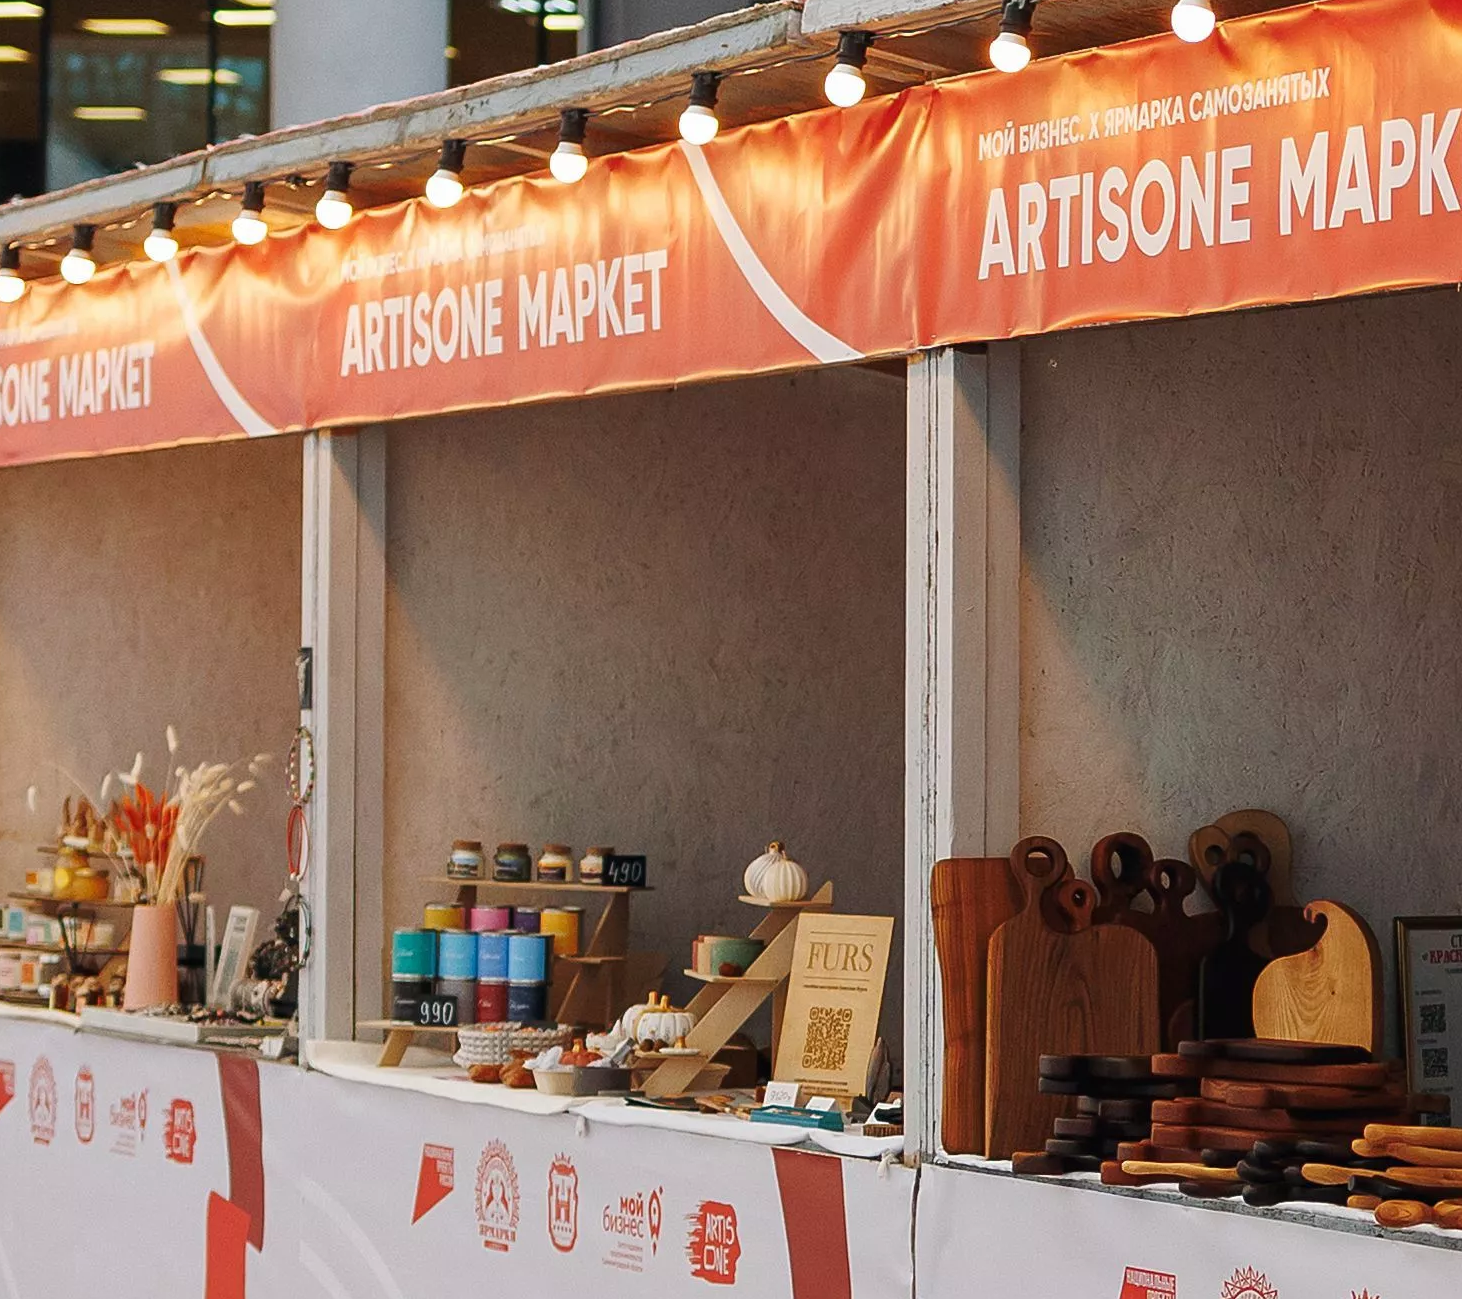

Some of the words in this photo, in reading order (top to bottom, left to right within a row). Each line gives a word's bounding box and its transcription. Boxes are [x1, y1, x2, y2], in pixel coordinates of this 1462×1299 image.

[978, 119, 1015, 161] МОЙ
[1019, 112, 1085, 156] БИЗНЕС.
[1103, 95, 1185, 138] ЯРМАРКА
[1189, 67, 1331, 123] САМОЗАНЯТЫХ
[978, 145, 1252, 280] ARTISONE
[340, 279, 504, 377] ARTISONE
[518, 249, 667, 350] МАРКЕТ
[58, 341, 155, 419] МАРКЕТ
[609, 864, 642, 883] 490
[806, 942, 874, 972] FURS
[421, 1002, 453, 1025] 990
[620, 1192, 643, 1217] мой
[603, 1205, 643, 1238] бизнес
